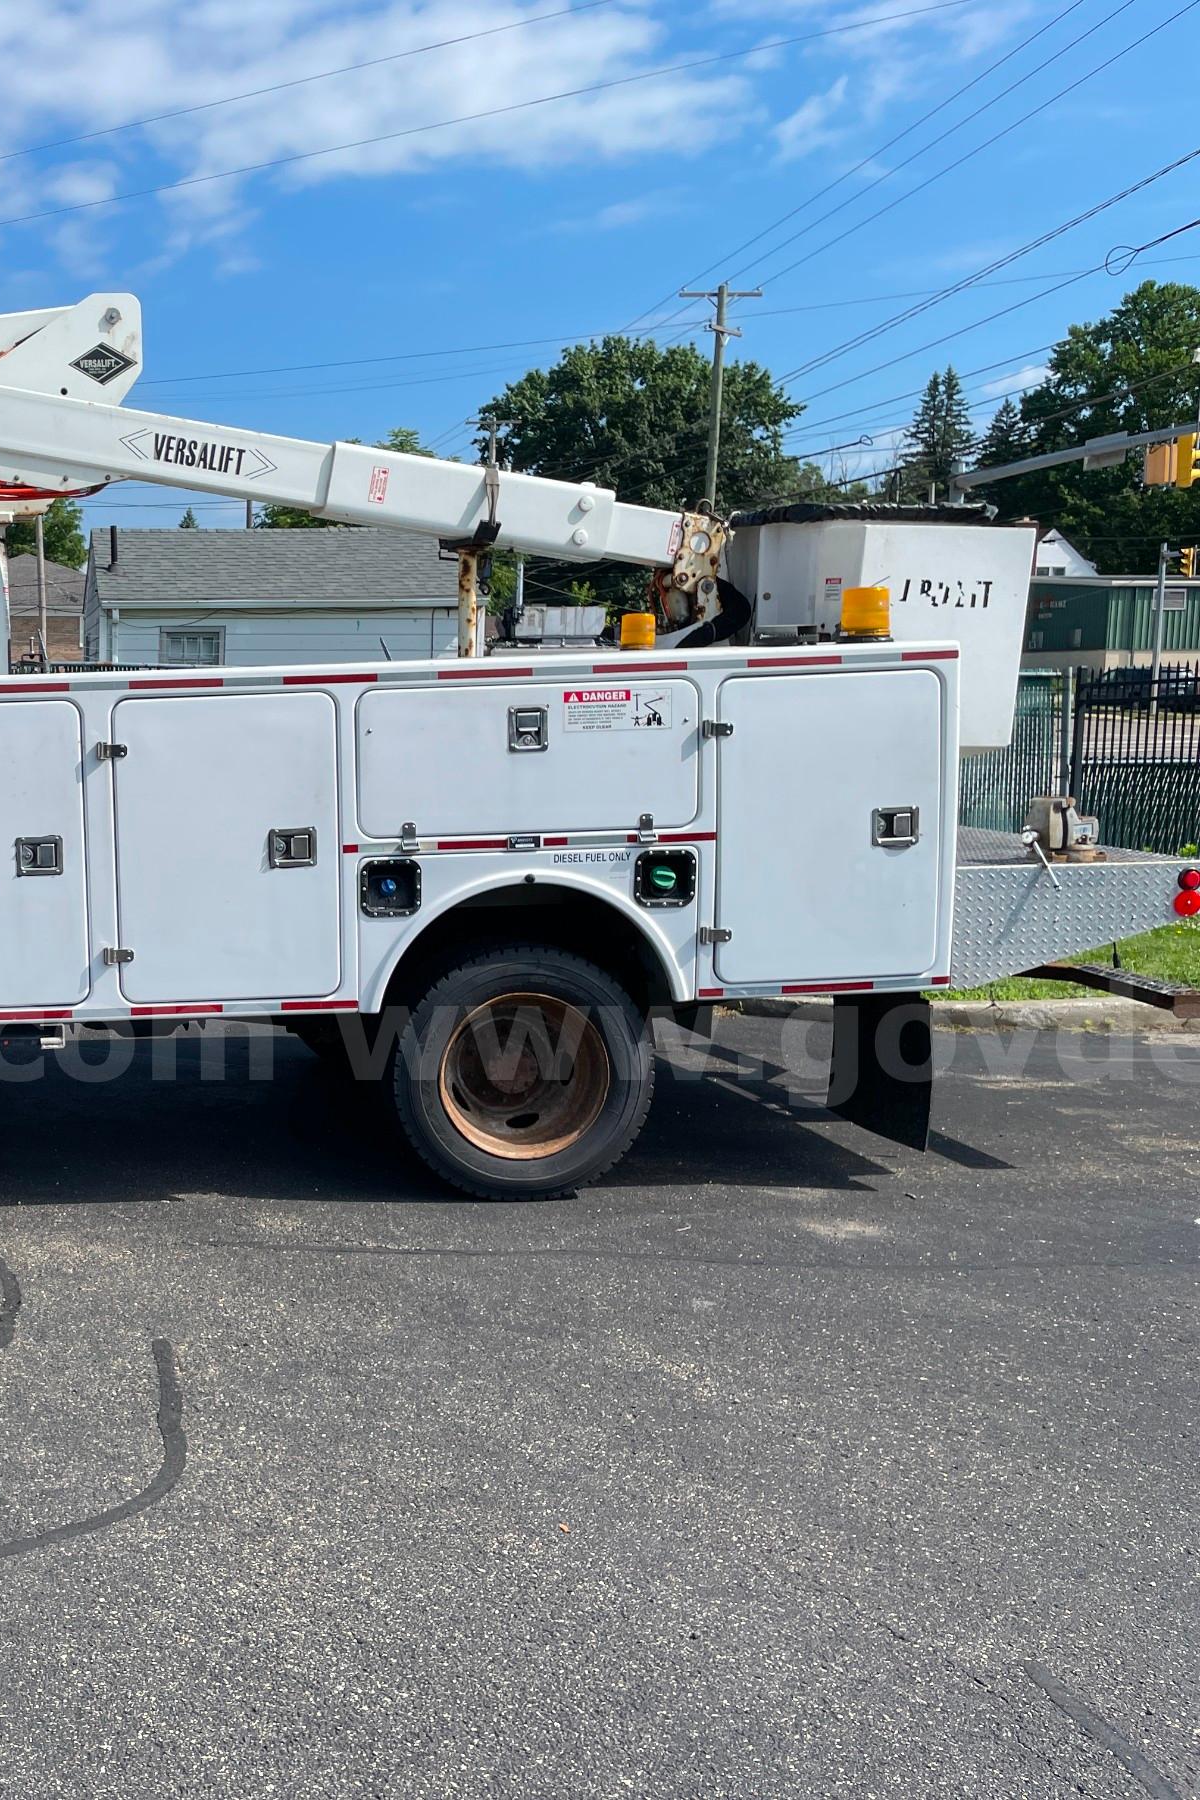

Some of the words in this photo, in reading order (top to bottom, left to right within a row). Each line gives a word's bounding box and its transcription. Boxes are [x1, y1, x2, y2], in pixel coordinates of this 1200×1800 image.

[80, 359, 115, 368] VERSALIFT
[153, 433, 246, 475] VERSALIFT
[582, 691, 626, 701] DANGER
[553, 853, 583, 863] DIESEL
[585, 852, 607, 861] FUEL
[608, 852, 631, 861] ONLY
